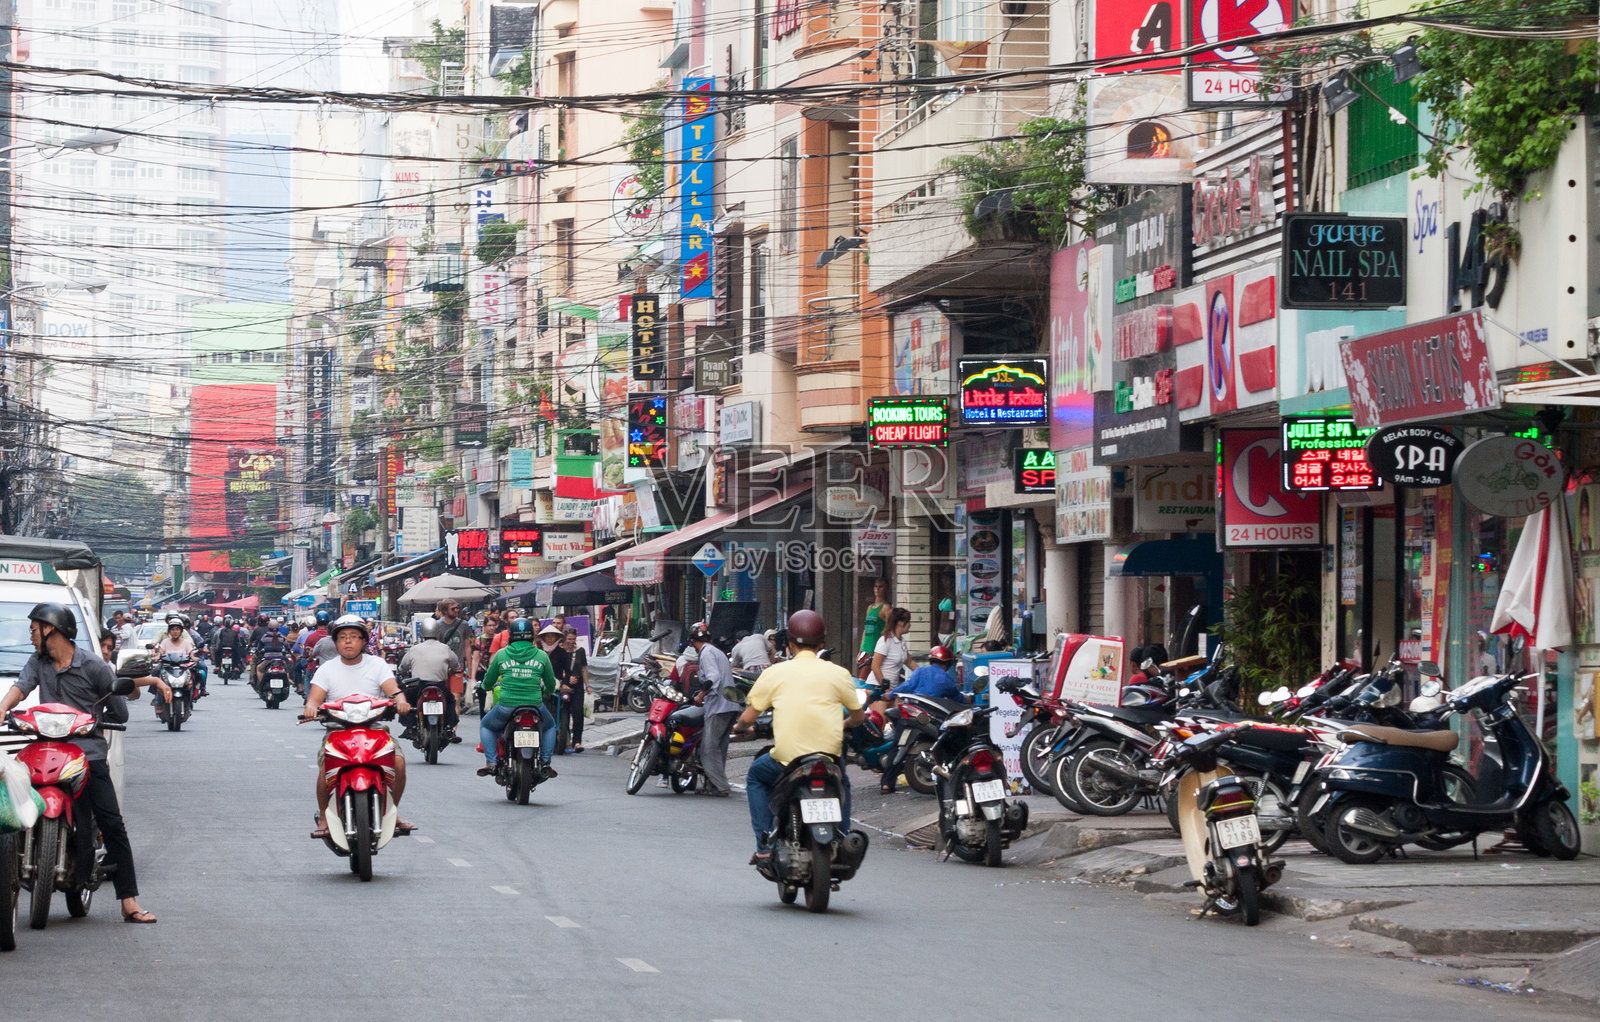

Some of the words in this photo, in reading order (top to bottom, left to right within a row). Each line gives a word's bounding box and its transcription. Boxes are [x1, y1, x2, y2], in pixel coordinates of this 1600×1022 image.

[1205, 79, 1223, 93] 24
[1230, 79, 1282, 94] HOUS
[396, 172, 419, 182] KIM'S
[689, 92, 709, 249] STELLAR
[1308, 224, 1385, 246] JULIE
[1292, 250, 1351, 283] NAIL
[1360, 248, 1400, 283] SPA
[1328, 281, 1369, 301] 141
[636, 301, 656, 373] HOTEL
[703, 361, 728, 373] Ryan's
[703, 371, 720, 381] Pub
[965, 389, 1004, 406] Little
[1010, 388, 1044, 406] India
[873, 408, 913, 422] BOOKING
[914, 407, 943, 421] TOURS
[966, 409, 988, 421] Hotel
[991, 410, 997, 419] &
[999, 409, 1044, 421] Restaurant
[875, 426, 907, 441] CHEAP
[909, 426, 942, 440] FLIGHT
[1288, 424, 1325, 437] JULIE
[1327, 423, 1352, 437] SPA
[1383, 429, 1408, 443] RELAX
[1410, 429, 1431, 437] BODY
[1433, 432, 1456, 446] CARE
[1301, 451, 1331, 462] 스파
[1337, 450, 1366, 461] 네일
[1395, 445, 1446, 471] SPA
[1294, 462, 1323, 474] 얼굴
[1294, 475, 1323, 486] 어서
[1330, 475, 1374, 486] 오세요
[1421, 476, 1441, 484] 3Am
[858, 530, 890, 541] Jan's
[1231, 527, 1250, 541] 24
[1254, 525, 1314, 541] HOURS
[12, 564, 40, 574] TAXI
[990, 665, 1020, 678] Special
